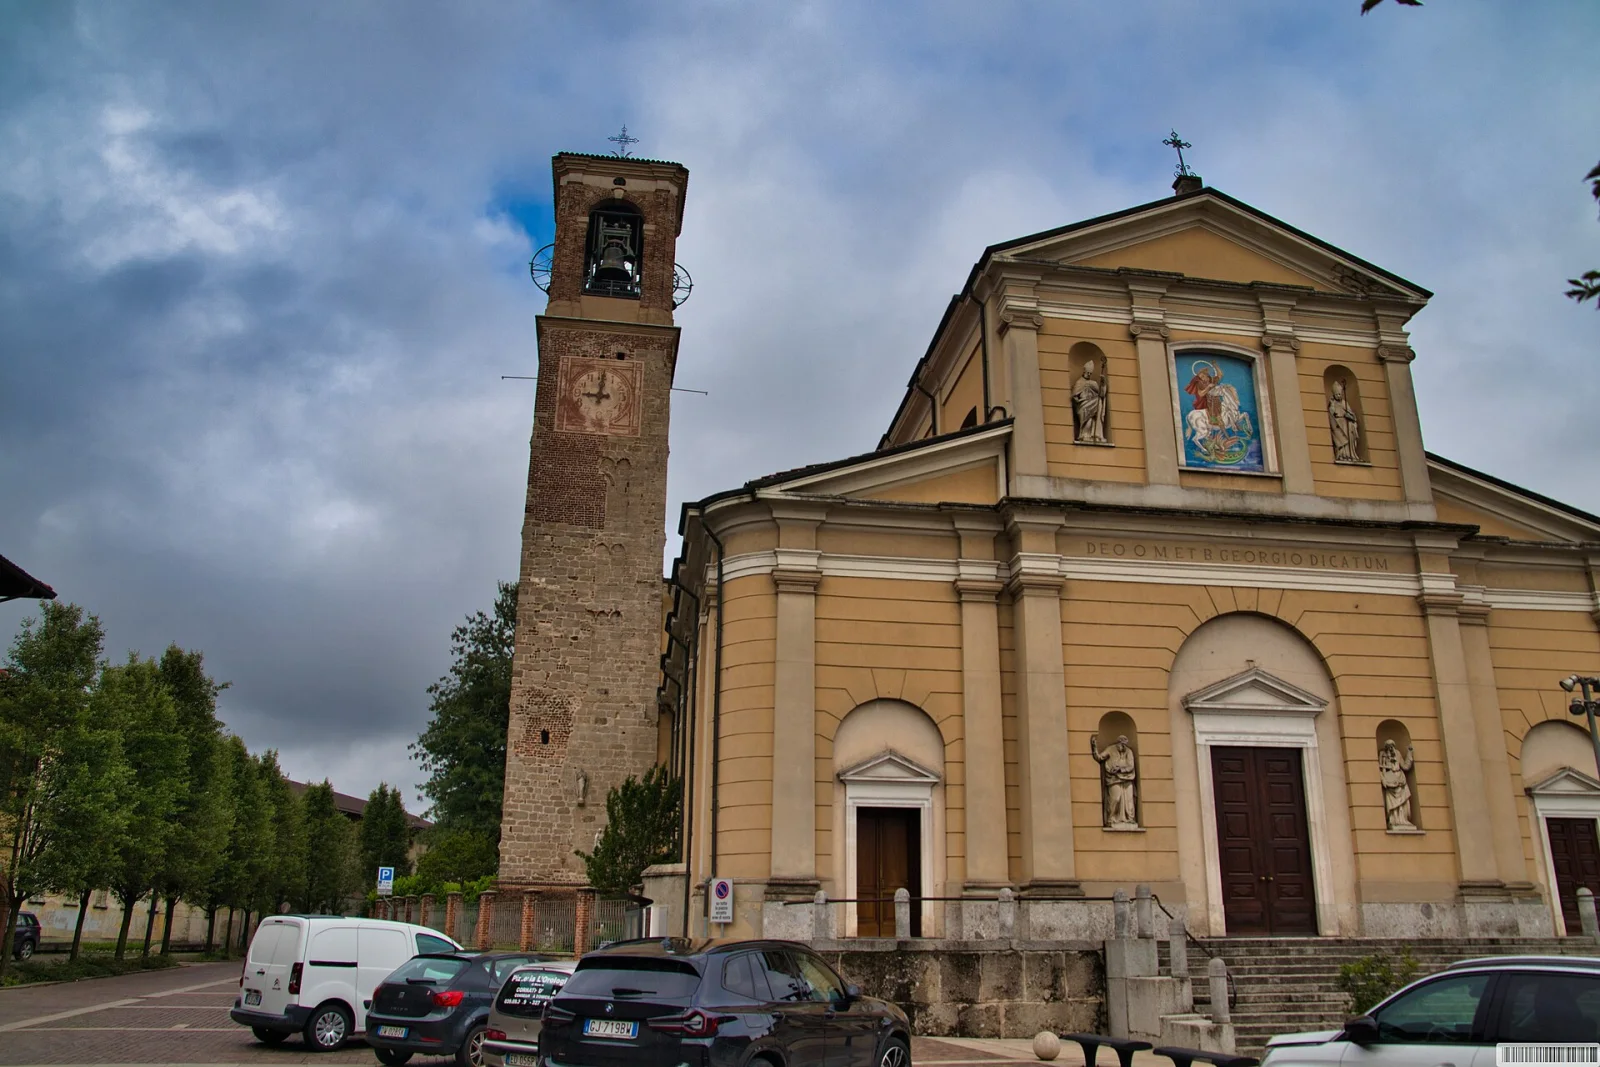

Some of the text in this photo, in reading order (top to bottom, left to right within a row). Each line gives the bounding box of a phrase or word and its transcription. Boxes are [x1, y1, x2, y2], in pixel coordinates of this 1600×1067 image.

[574, 388, 581, 397] 9
[1086, 541, 1126, 556] DEO
[1220, 550, 1302, 566] GEORGIO
[1310, 554, 1388, 570] DICATUM
[382, 870, 390, 880] P
